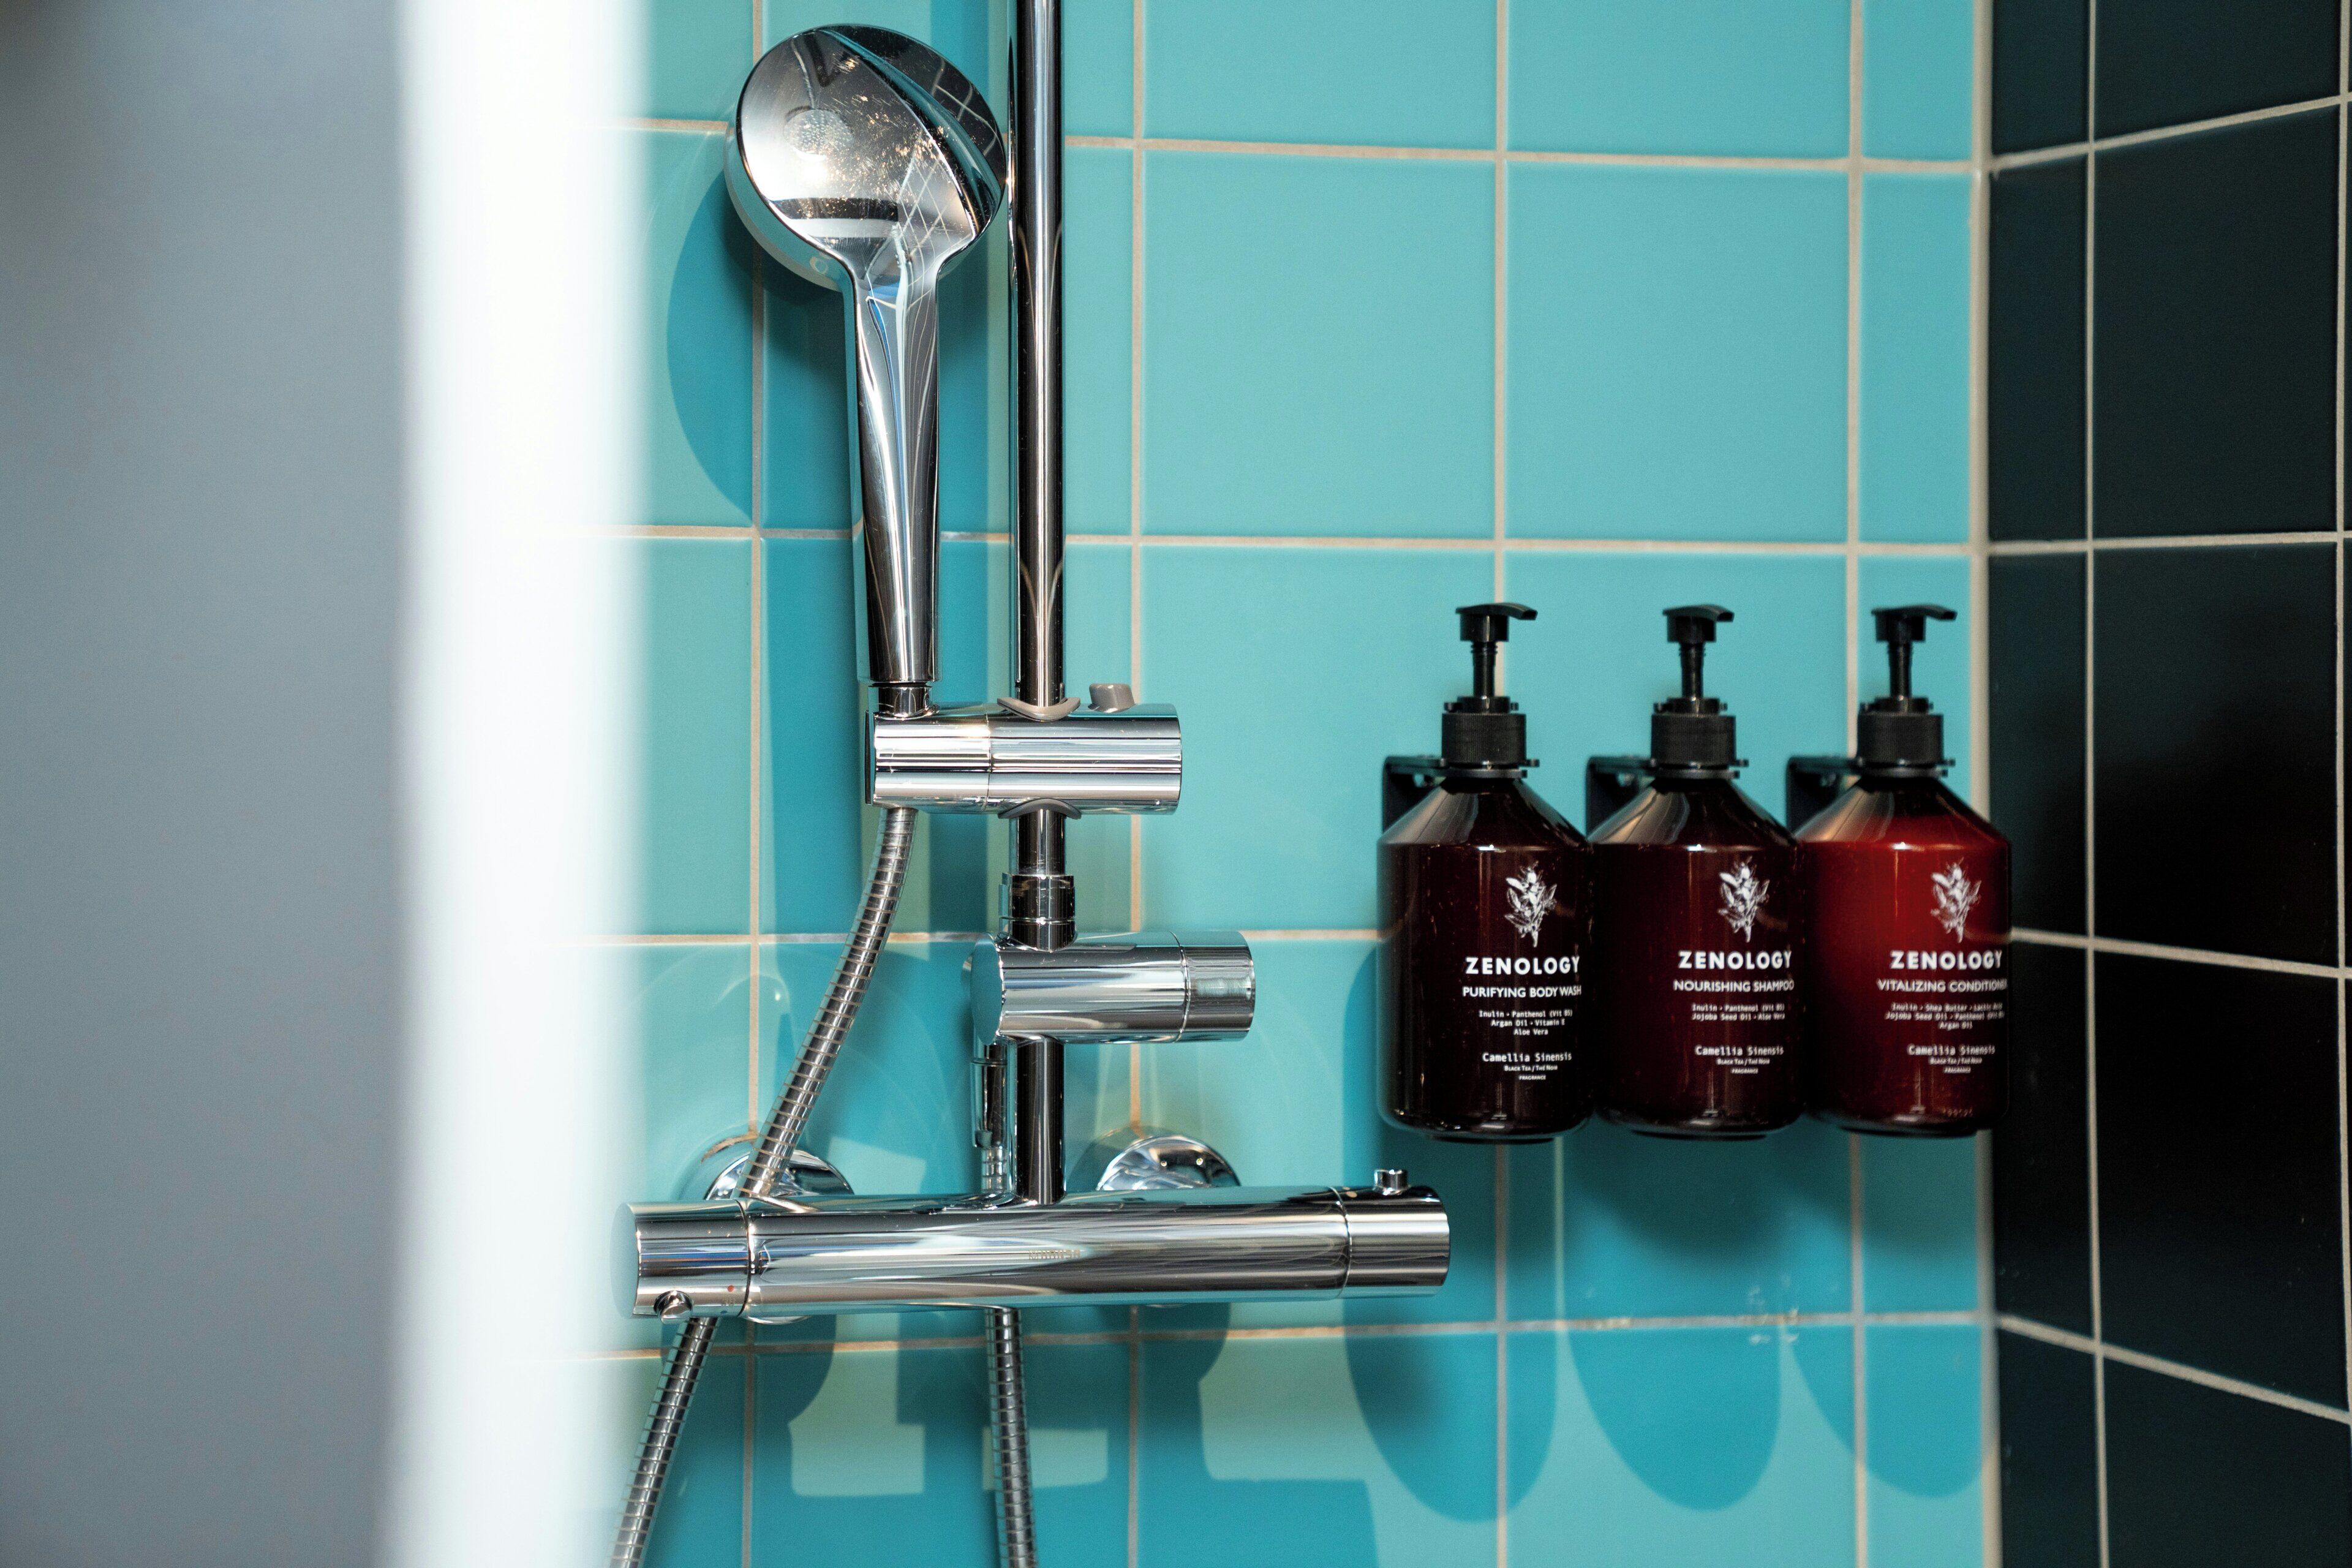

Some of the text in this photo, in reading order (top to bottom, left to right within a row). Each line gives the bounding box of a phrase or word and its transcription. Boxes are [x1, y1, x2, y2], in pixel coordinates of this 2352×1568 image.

[1465, 956, 1580, 975] ZENOLOGY
[1678, 950, 1792, 970] ZENOLOGY
[1890, 949, 2003, 970] ZENOLOGY
[1673, 978, 1795, 992] NOURISHING SHAMPOO
[1876, 978, 1946, 992] VITALIZING
[1462, 986, 1581, 998] PURIFYING BODY WASH
[1692, 1012, 1717, 1021] Jojoba
[1695, 1044, 1784, 1056] Camellia Sinensis
[1907, 1044, 1996, 1055] Camellia Sinensis
[1482, 1052, 1572, 1062] Camellia Sinensis
